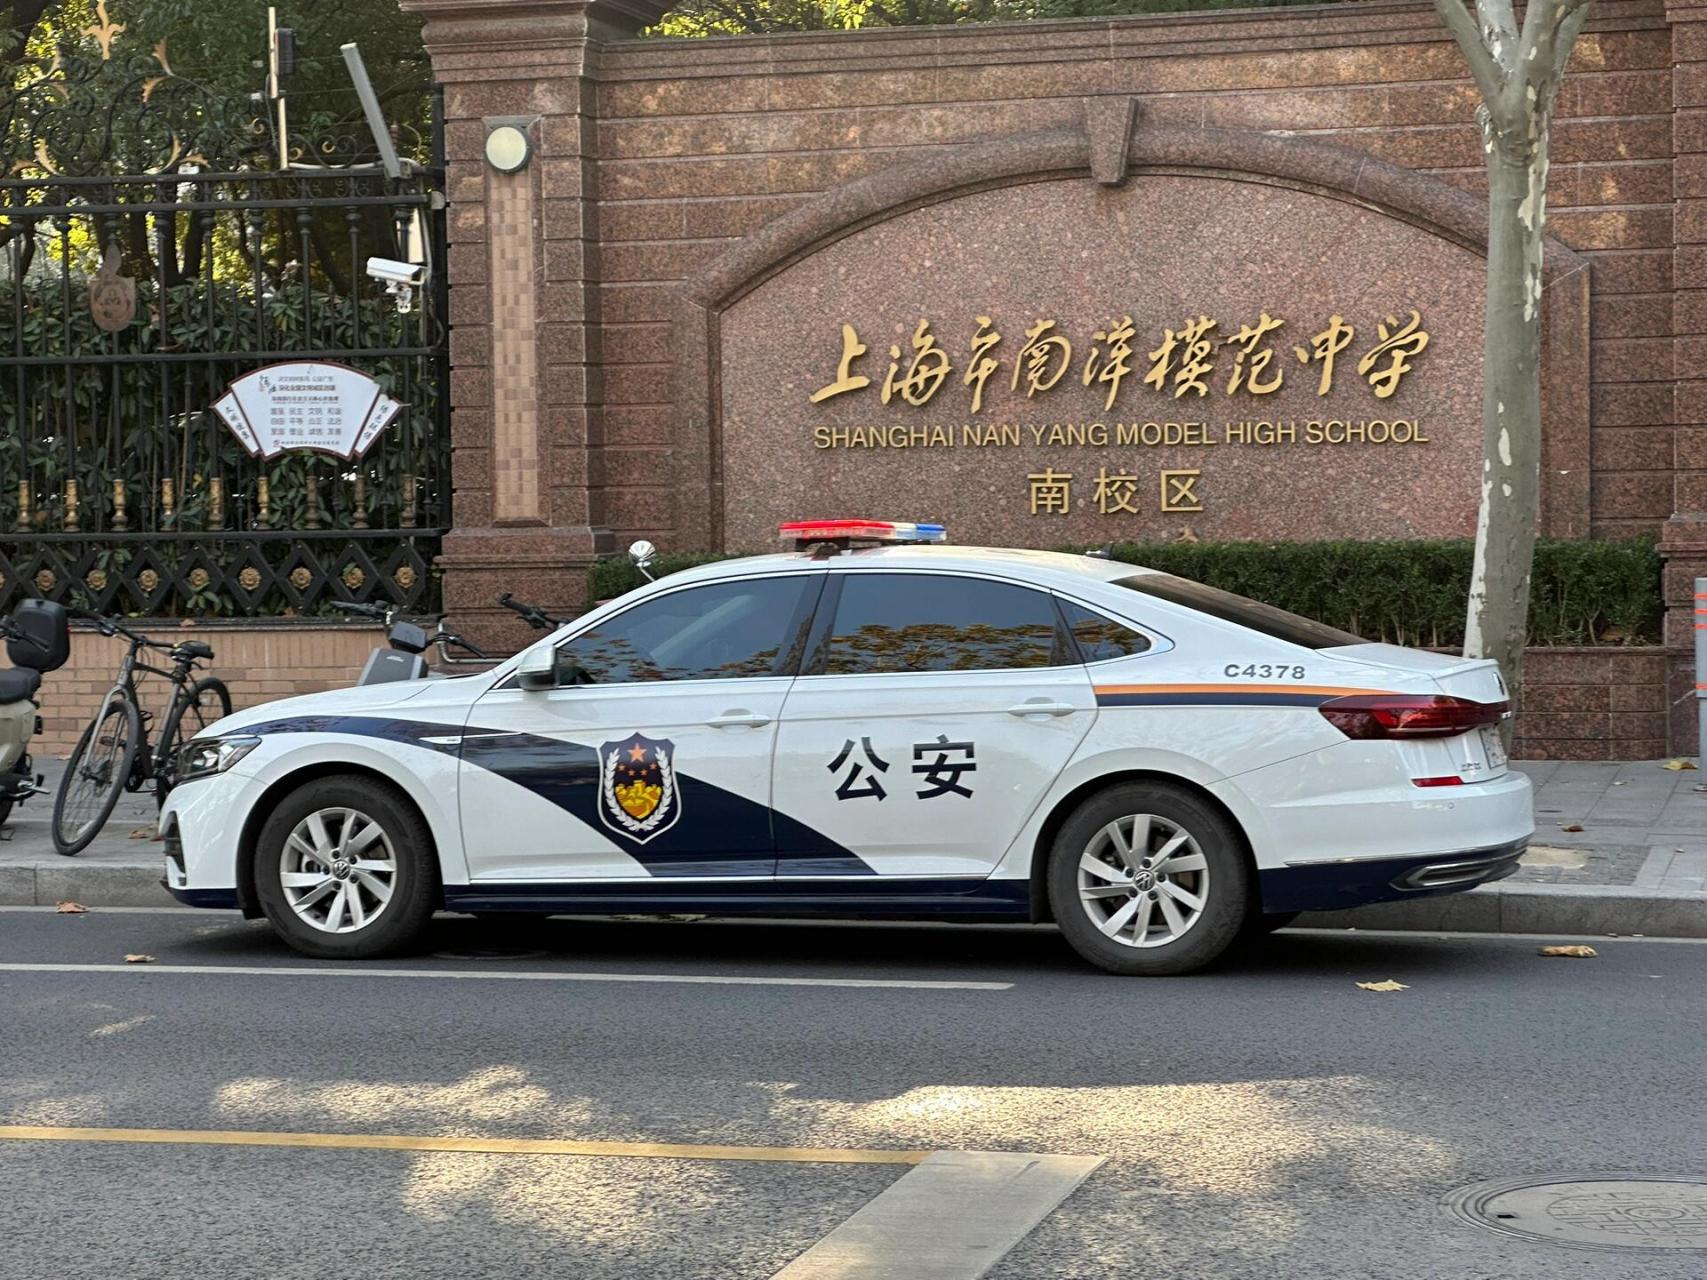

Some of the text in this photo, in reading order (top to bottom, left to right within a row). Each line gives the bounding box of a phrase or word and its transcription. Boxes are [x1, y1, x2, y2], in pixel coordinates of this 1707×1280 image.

[809, 310, 1430, 413] 上海市南洋模范中学
[813, 419, 1430, 449] SHANGHAI NAN YANG MODEL HIGH SCHOOL
[1026, 467, 1204, 515] 南校区
[1224, 663, 1306, 680] C4378
[826, 733, 977, 803] 公安
